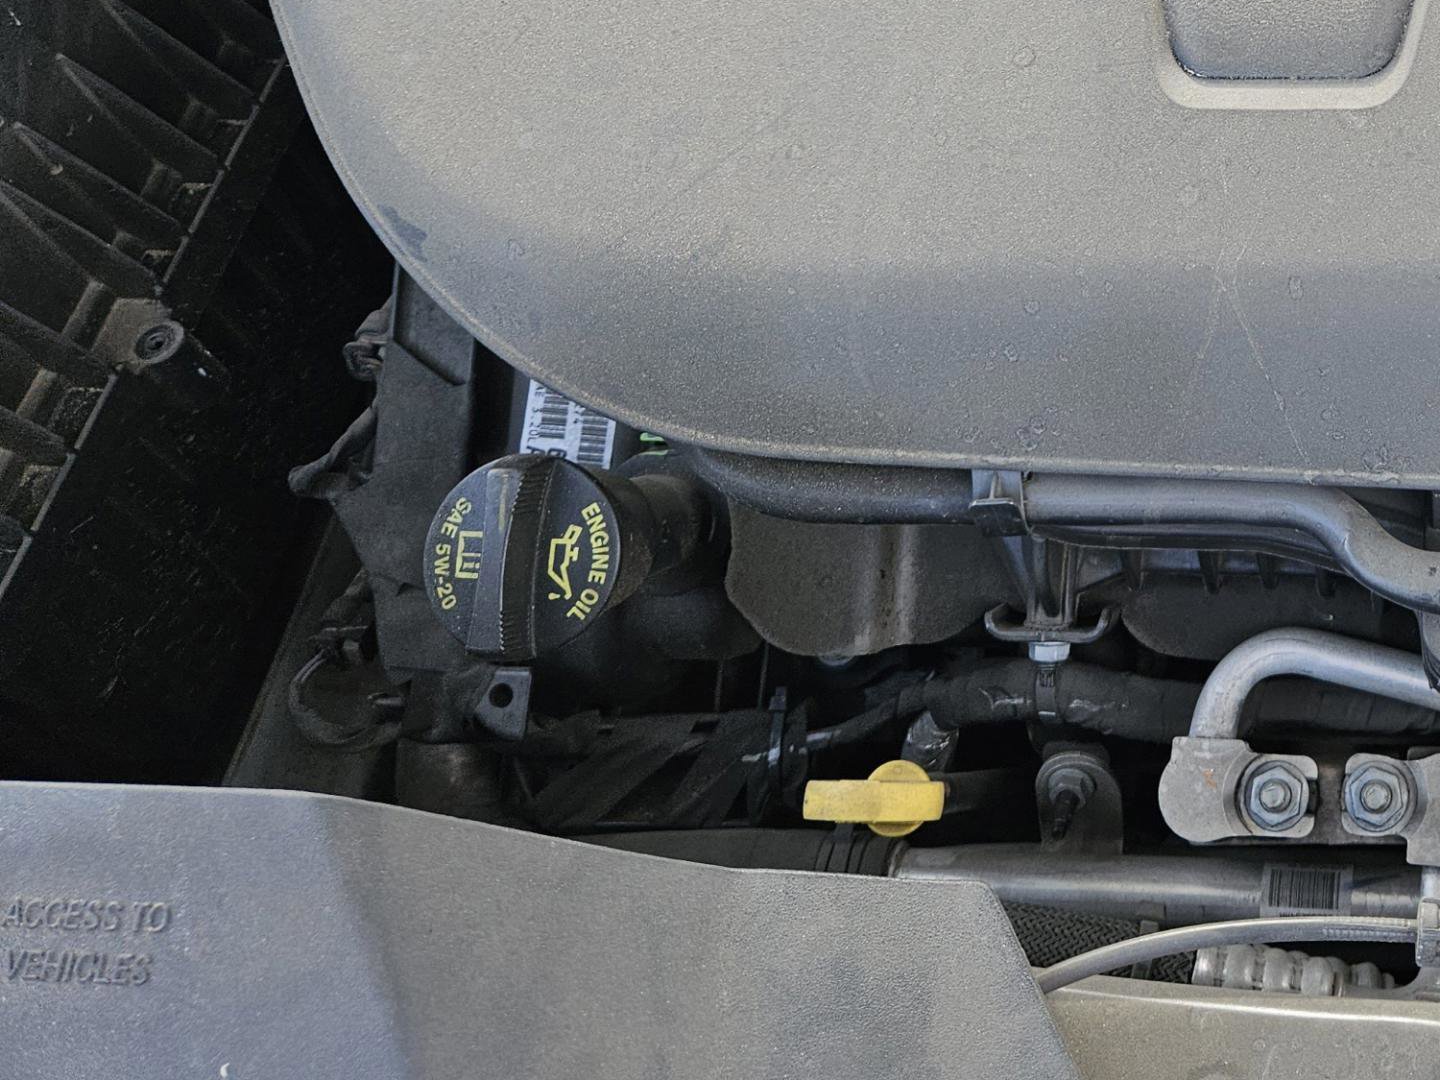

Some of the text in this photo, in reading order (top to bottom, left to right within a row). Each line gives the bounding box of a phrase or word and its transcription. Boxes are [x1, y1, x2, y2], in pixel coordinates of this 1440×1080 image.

[434, 497, 472, 610] SAE 5W-20
[566, 502, 610, 620] ENGINE OIL
[0, 895, 172, 933] ACCESS TO
[5, 948, 153, 986] VEHICLES
